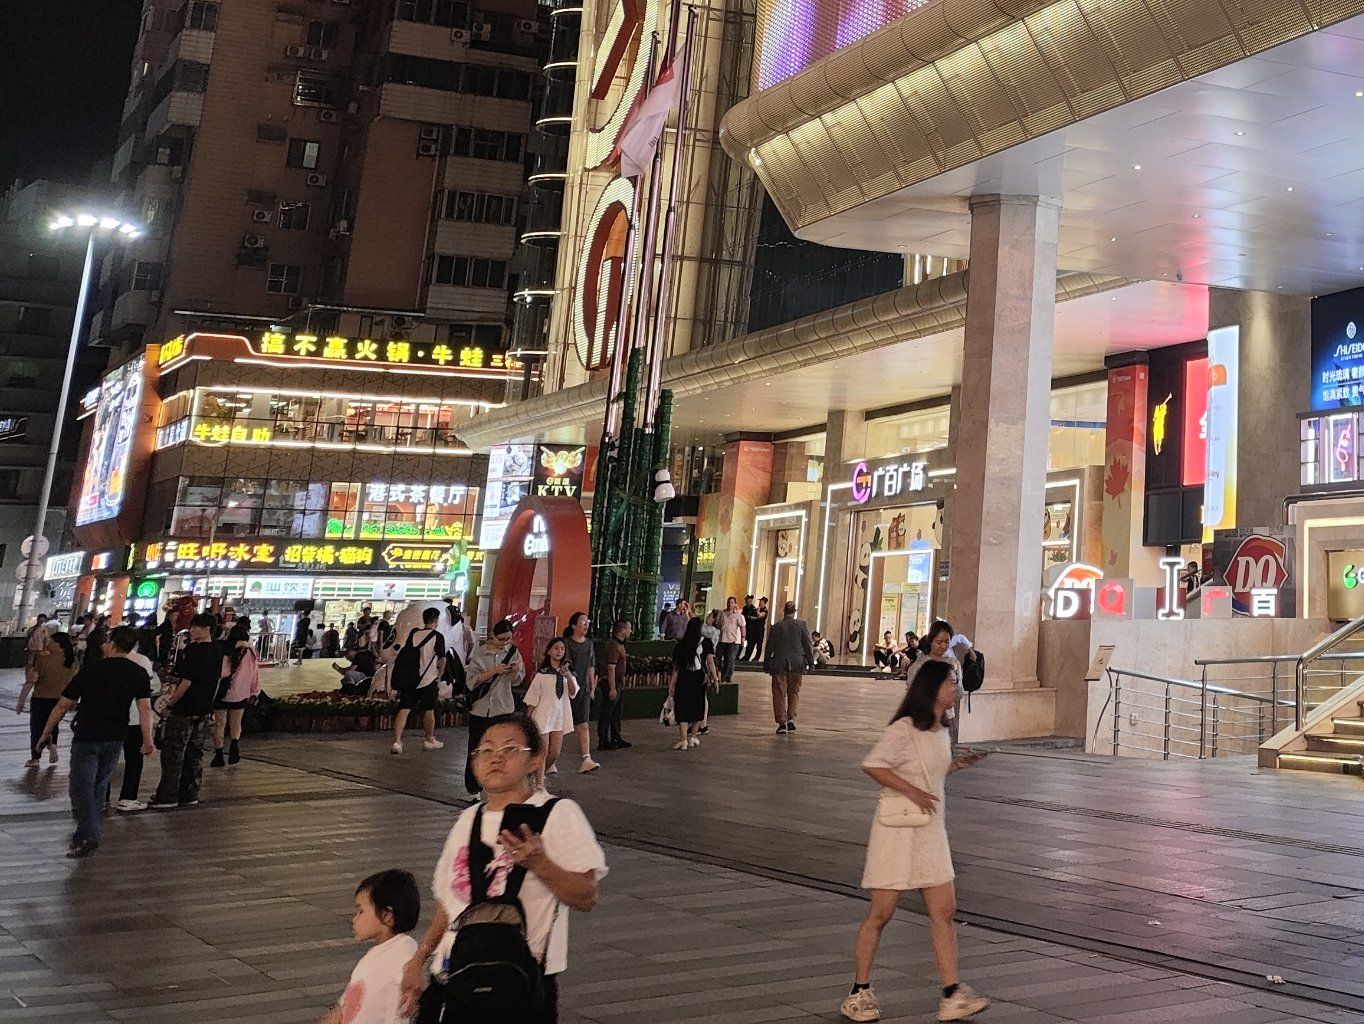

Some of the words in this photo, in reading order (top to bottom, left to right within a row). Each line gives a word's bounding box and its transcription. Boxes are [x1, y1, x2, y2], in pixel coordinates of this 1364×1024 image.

[194, 423, 272, 444] 牛蛙自助
[537, 485, 577, 498] KTV
[871, 461, 925, 499] 广百广场
[368, 482, 466, 505] 港式茶餐厅
[1235, 554, 1280, 594] DQ
